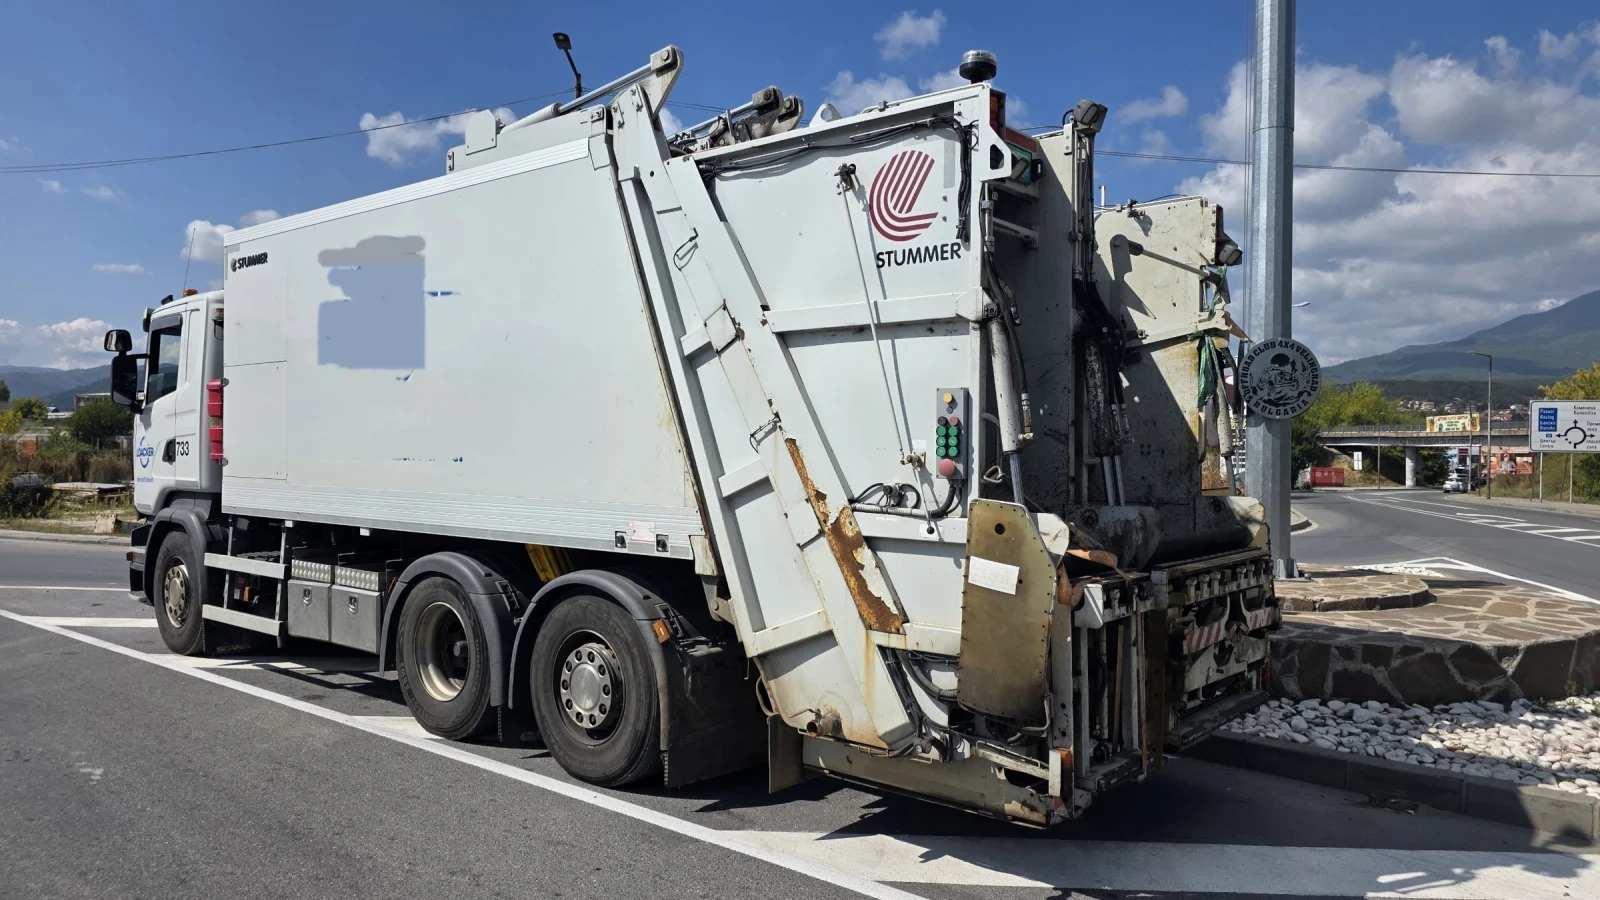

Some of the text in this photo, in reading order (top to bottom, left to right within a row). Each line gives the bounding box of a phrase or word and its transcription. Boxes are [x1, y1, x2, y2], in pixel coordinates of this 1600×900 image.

[237, 251, 269, 270] STUMMER
[876, 242, 962, 269] STUMMER
[1240, 355, 1256, 395] OFFROAD
[1253, 341, 1277, 357] CLUB
[1295, 346, 1319, 392] VELINGRAD
[1253, 399, 1309, 416] BULGARIA
[176, 441, 190, 457] 733
